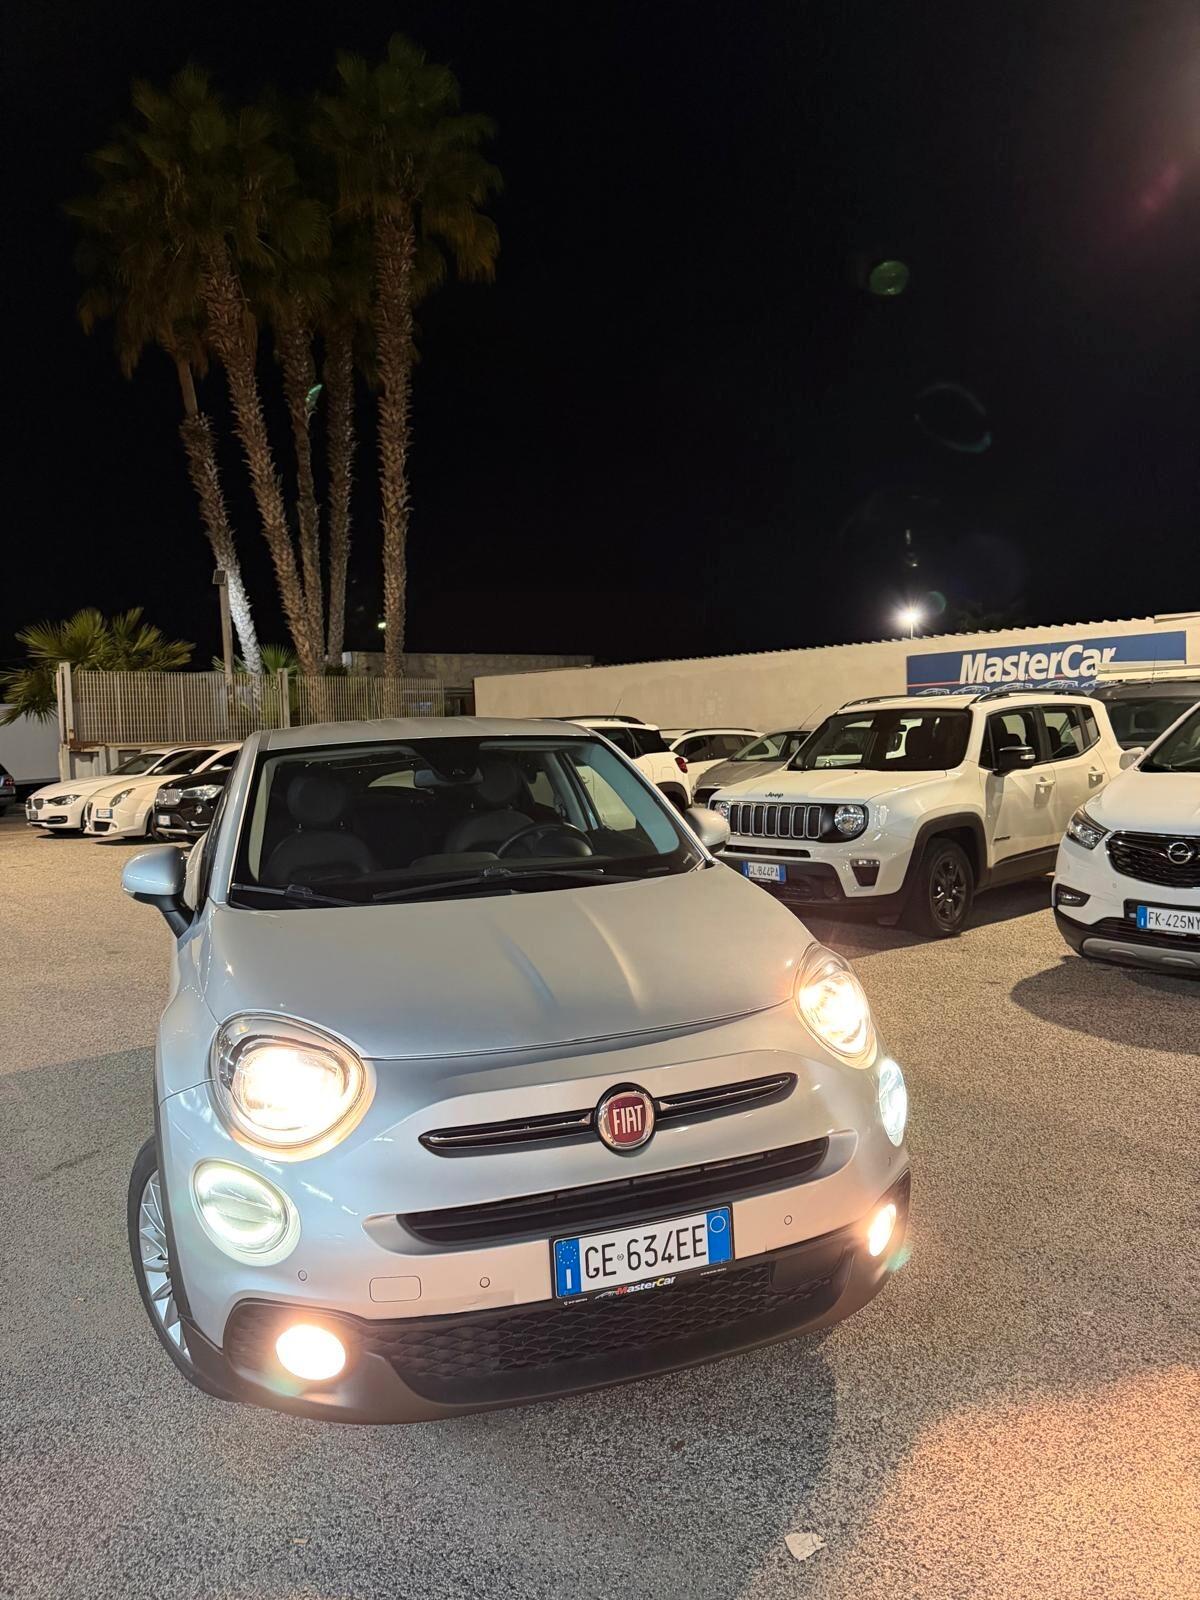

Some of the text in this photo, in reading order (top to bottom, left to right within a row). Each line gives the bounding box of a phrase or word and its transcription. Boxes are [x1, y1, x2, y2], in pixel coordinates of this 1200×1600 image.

[959, 644, 1116, 684] MasterCar
[613, 1105, 643, 1135] FIAT
[616, 1276, 676, 1295] MasterCar
